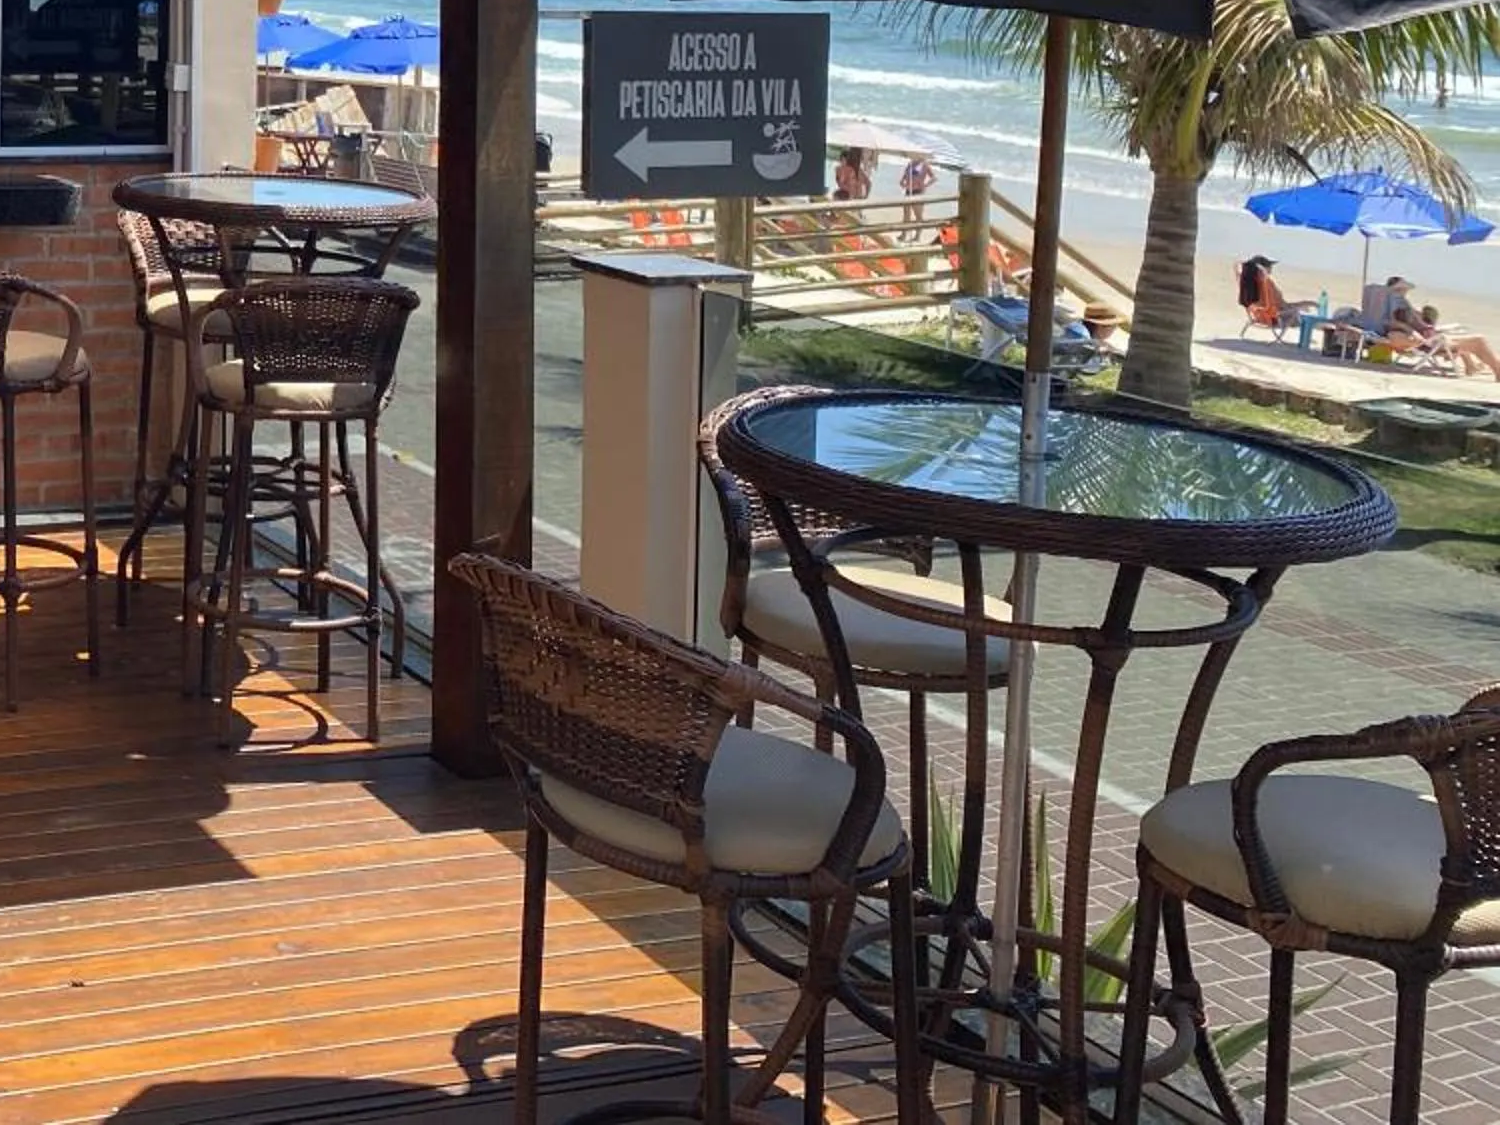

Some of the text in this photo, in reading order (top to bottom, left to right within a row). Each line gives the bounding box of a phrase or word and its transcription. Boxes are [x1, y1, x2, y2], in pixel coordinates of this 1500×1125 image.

[668, 32, 757, 71] ACESSO A
[619, 78, 802, 119] PETISCARIA DA VILA
